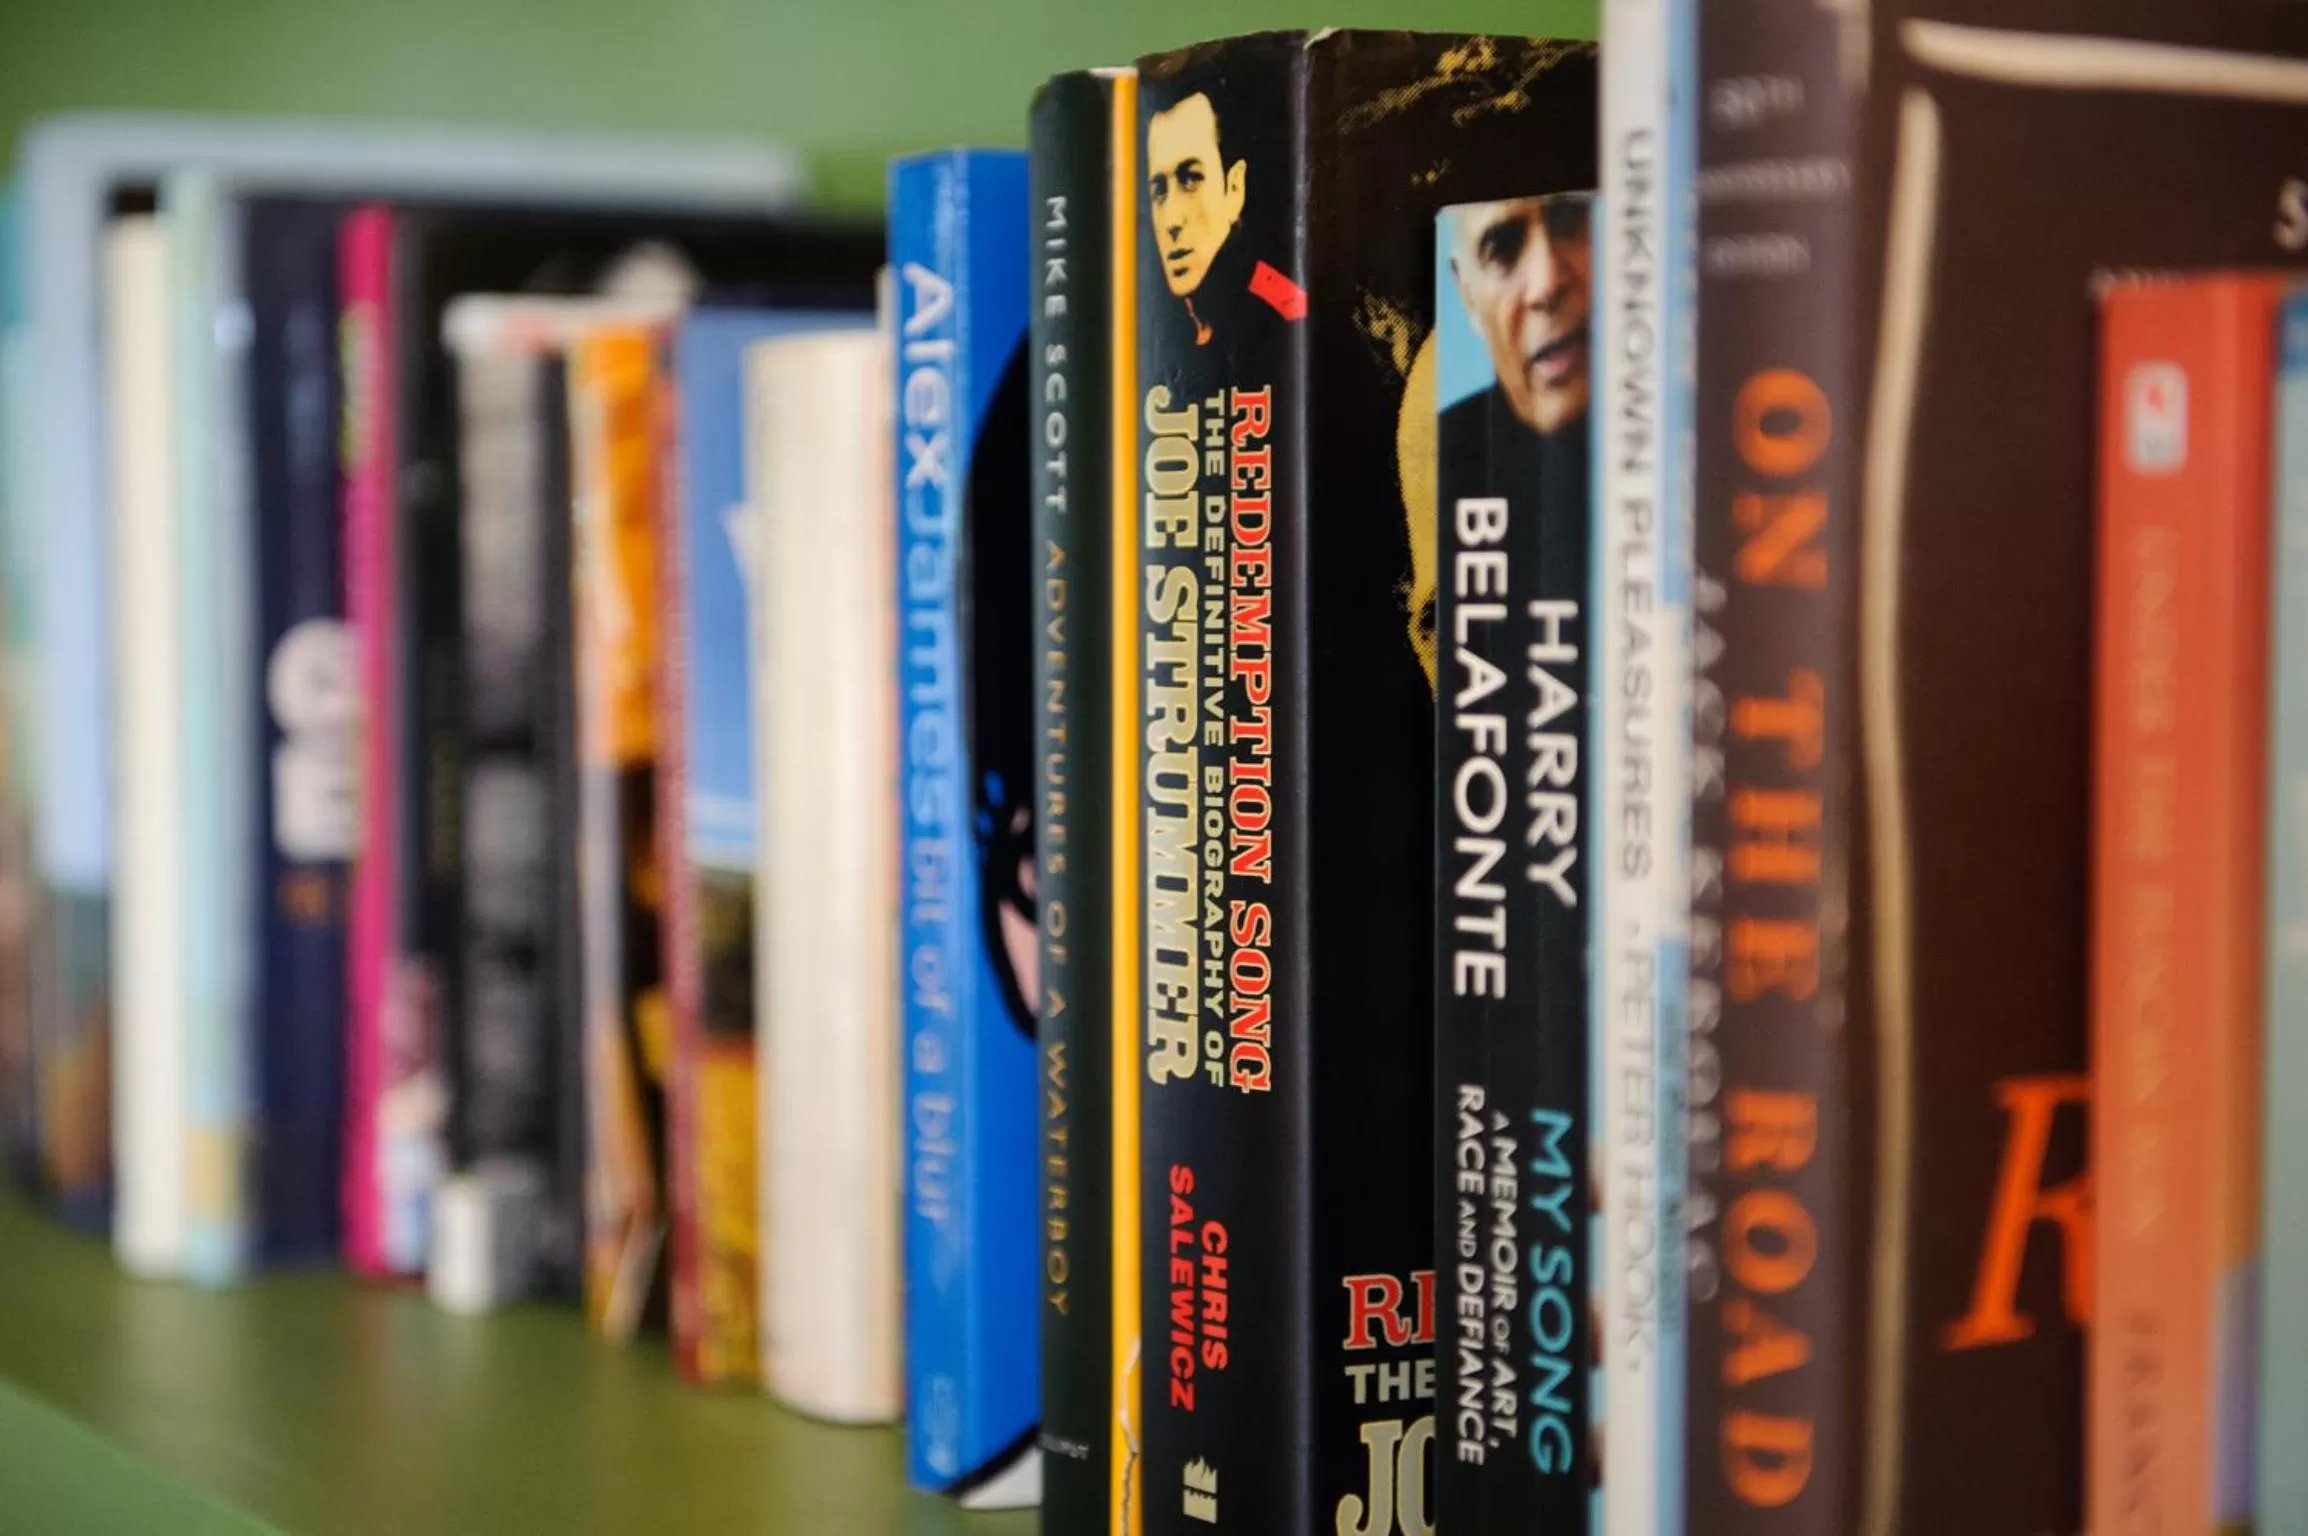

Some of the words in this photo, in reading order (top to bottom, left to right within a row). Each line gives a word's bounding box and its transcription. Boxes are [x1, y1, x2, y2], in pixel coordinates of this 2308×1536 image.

[1045, 196, 1067, 314] MIKE
[1620, 128, 1655, 473] UNKNOWN
[1045, 342, 1067, 513] SCOTT
[1145, 384, 1200, 549] JOE
[1205, 389, 1226, 477] THE
[1732, 368, 1834, 590] ON
[1045, 540, 1069, 875] ADVENTURES
[1205, 503, 1226, 747] DEFINITIVE
[1230, 385, 1272, 883] REDEMPTION
[1619, 499, 1656, 879] PLEASURES
[1145, 564, 1200, 1086] STRUMMER
[1454, 496, 1509, 999] BELAFONTE
[1529, 598, 1578, 909] HARRY
[1729, 671, 1824, 1001] THE
[913, 943, 954, 1018] of
[1046, 899, 1068, 964] OF
[1205, 766, 1225, 1021] BIOGRAPHY
[913, 1031, 946, 1075] a
[1047, 986, 1068, 1019] A
[1204, 1032, 1225, 1087] OF
[1230, 900, 1272, 1094] SONG
[1621, 948, 1655, 1149] PETER
[915, 1093, 954, 1227] blur
[1046, 1040, 1069, 1316] WATERBOY
[1457, 1084, 1485, 1195] RACE
[1492, 1110, 1511, 1132] A
[1528, 1107, 1574, 1234] MY
[1170, 1164, 1196, 1412] SALEWICZ
[1201, 1219, 1229, 1371] CHRIS
[1458, 1199, 1476, 1258] AND
[1490, 1137, 1519, 1312] MEMOIR
[1723, 1088, 1817, 1508] ROAD
[1457, 1264, 1485, 1466] DEFIANCE
[1488, 1357, 1518, 1449] ART,
[1491, 1317, 1511, 1356] OF
[1528, 1242, 1574, 1475] SONG
